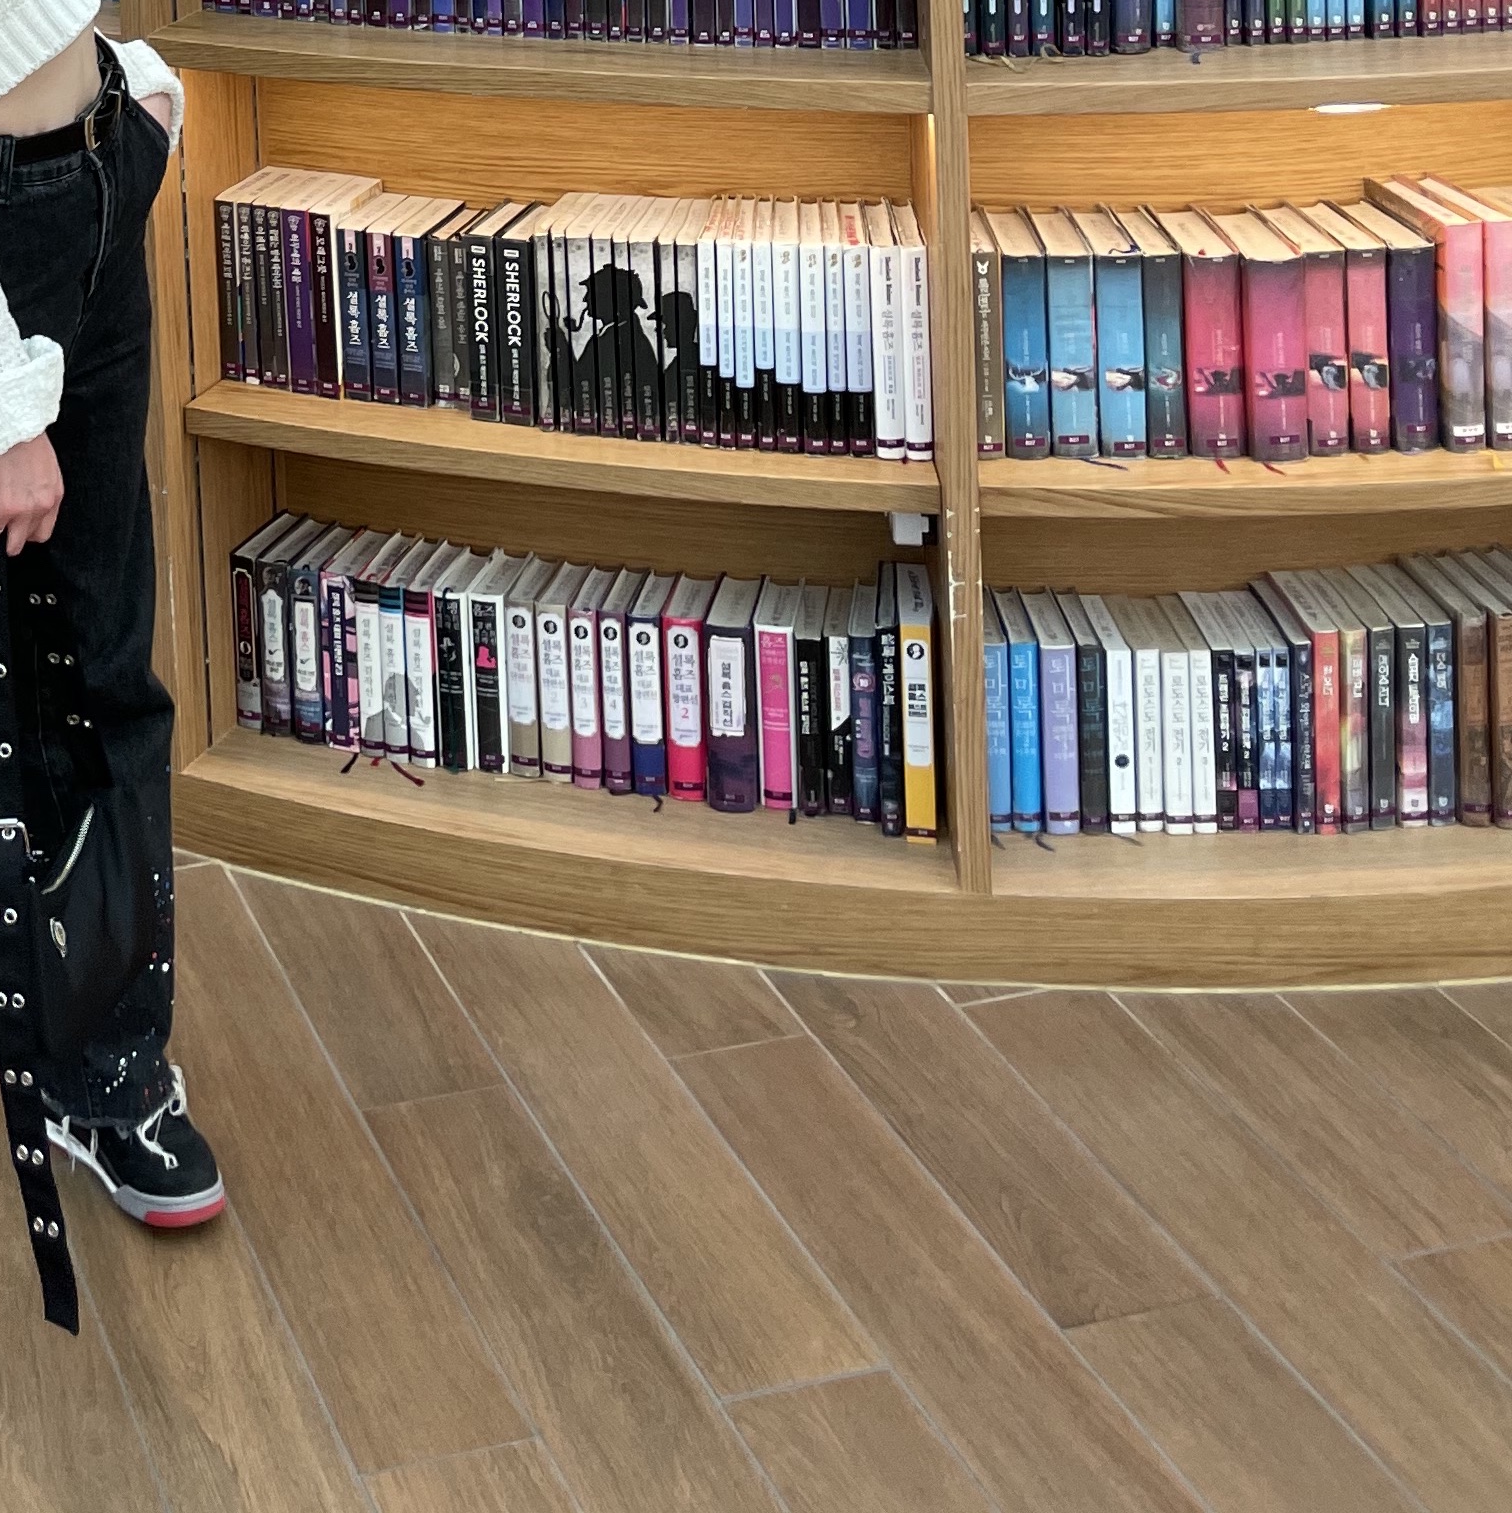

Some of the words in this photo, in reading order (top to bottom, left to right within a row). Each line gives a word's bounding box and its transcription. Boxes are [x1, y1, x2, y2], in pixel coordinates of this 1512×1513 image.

[345, 290, 361, 319] 셜록
[374, 294, 389, 323] 셜록
[402, 297, 418, 326] 셜록
[470, 257, 489, 344] SHERLOCK
[504, 260, 522, 348] SHERLOCK
[347, 319, 362, 346] 홈즈
[376, 323, 391, 349] 홈즈
[404, 326, 419, 353] 홈즈
[511, 633, 530, 647] 셜록
[511, 646, 531, 660] 홈즈
[542, 639, 562, 654] 셜록
[574, 644, 592, 658] 셜록
[604, 645, 620, 659] 셜록
[543, 653, 563, 666] 홈즈
[574, 659, 592, 672] 홈즈
[604, 659, 620, 673] 홈즈
[634, 650, 656, 664] 셜록
[634, 664, 656, 677] 홈즈
[672, 653, 696, 668] 셜록
[672, 668, 696, 681] 홈즈
[1011, 650, 1037, 721] 퇴마록
[1048, 653, 1076, 723] 퇴마록
[1142, 674, 1157, 722] 로도스도
[1170, 674, 1185, 724] 로도스도
[1195, 674, 1210, 723] 로도스도
[1144, 726, 1157, 754] 전기
[1173, 727, 1185, 755] 전기
[1196, 726, 1211, 754] 전기
